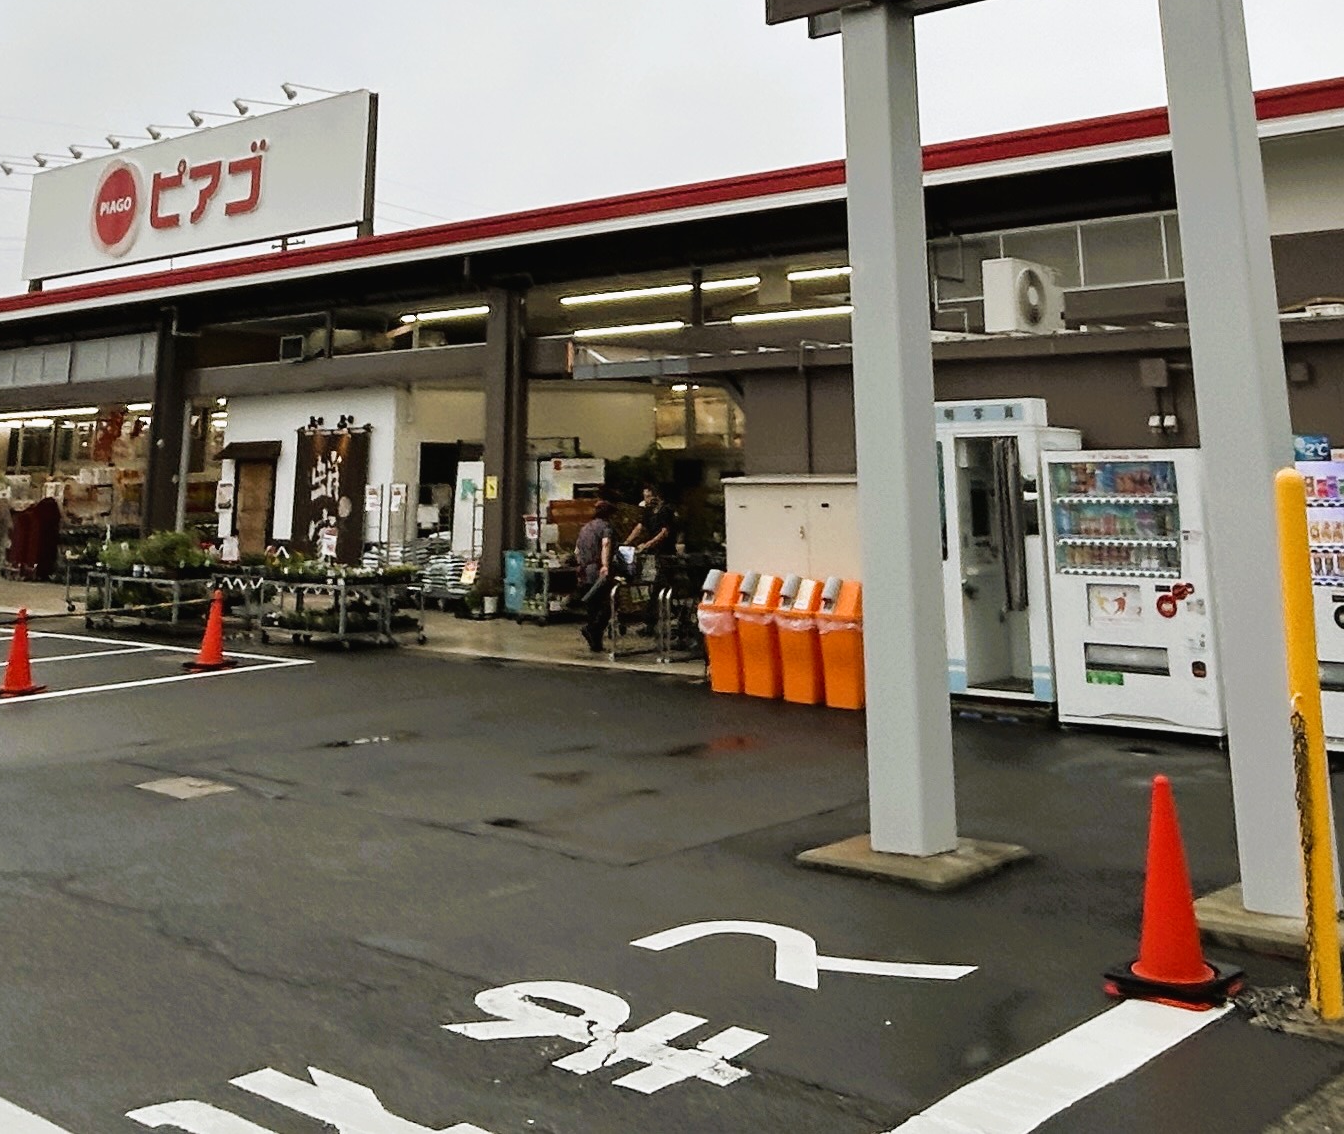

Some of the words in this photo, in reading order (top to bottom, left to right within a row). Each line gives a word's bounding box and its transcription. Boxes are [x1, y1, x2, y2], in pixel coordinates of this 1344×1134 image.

[99, 196, 132, 216] PIAGO
[150, 138, 267, 229] ピアゴ
